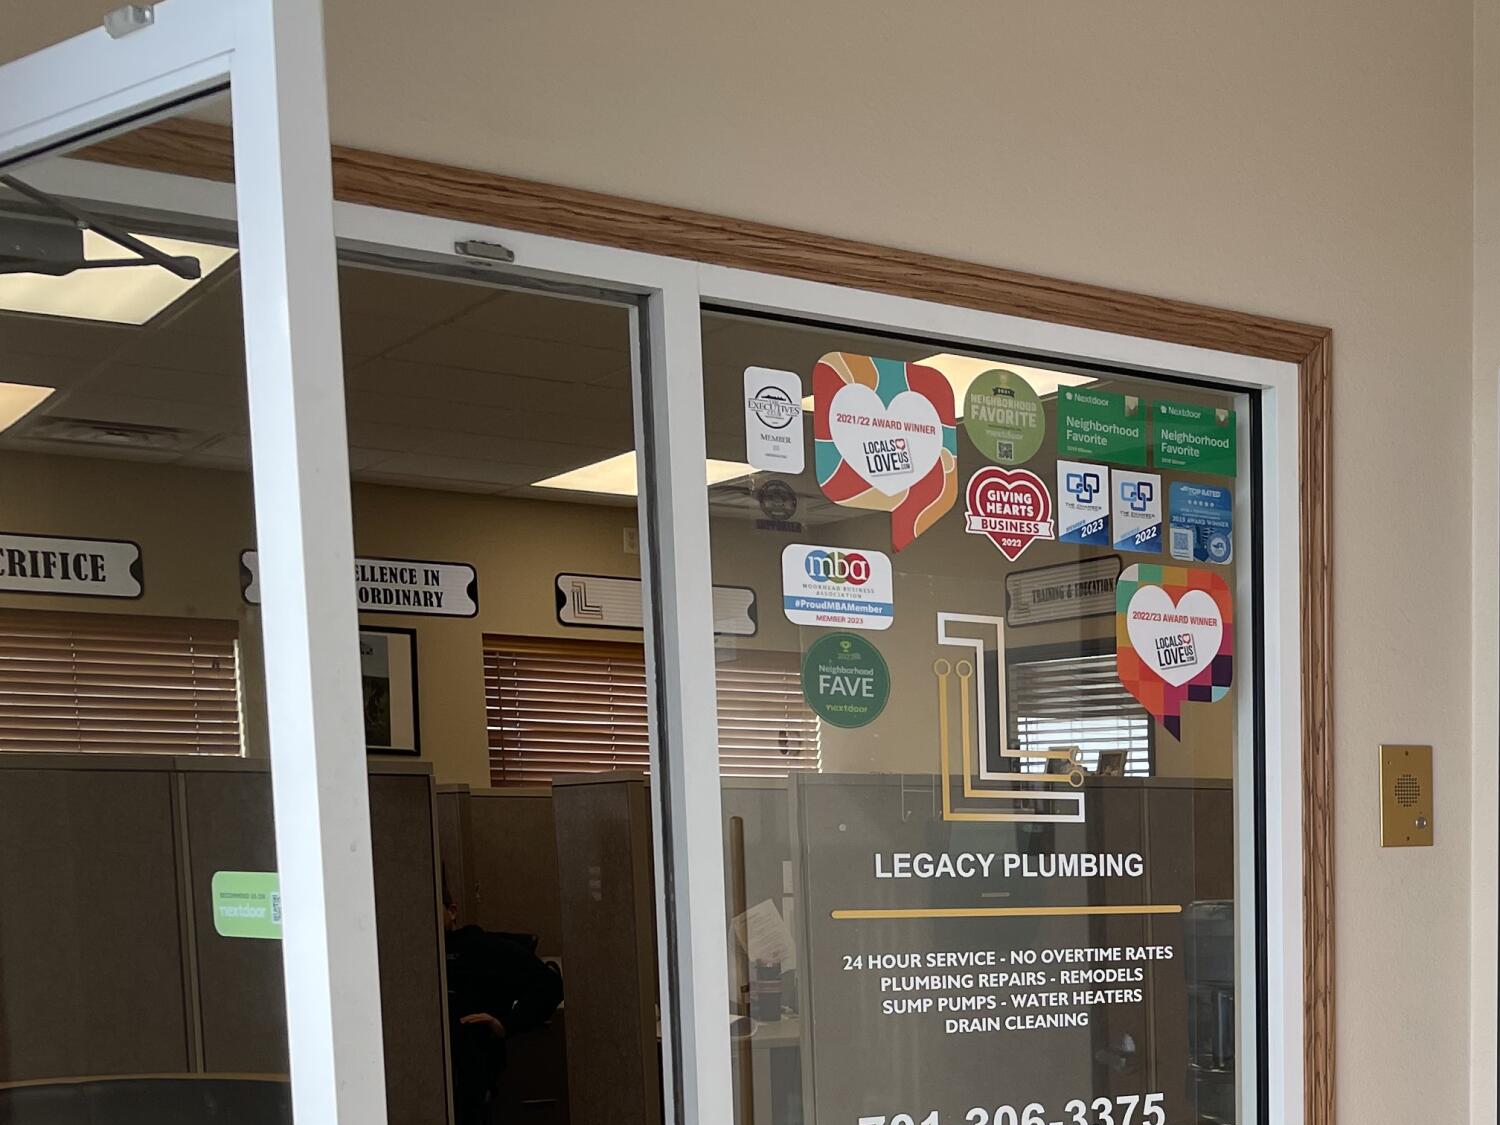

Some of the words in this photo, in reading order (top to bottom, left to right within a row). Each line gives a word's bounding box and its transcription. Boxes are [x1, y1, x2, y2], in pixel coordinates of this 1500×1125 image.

[748, 400, 800, 415] EXECUTIVES
[971, 393, 1037, 411] NEIGHBORHOOD
[1074, 393, 1109, 406] Nextdoor
[971, 404, 1037, 428] FAVORITE
[1168, 406, 1201, 419] Nextdoor
[836, 413, 870, 426] 2021/22
[872, 418, 902, 431] AWARD
[904, 422, 936, 435] WINNER
[1066, 415, 1139, 438] Neighborhood
[760, 433, 791, 444] MEMBER
[1066, 429, 1108, 446] Favorite
[1161, 428, 1230, 449] Neighborhood
[863, 439, 896, 455] LOCALS
[1161, 442, 1200, 458] Favorite
[866, 452, 900, 474] LOVE
[897, 451, 909, 463] US
[987, 490, 1032, 505] GIVING
[986, 502, 1034, 517] HEARTS
[981, 518, 1040, 533] BUSINESS
[1081, 518, 1104, 538] 2023
[1002, 538, 1022, 547] 2022
[1135, 526, 1157, 545] 2022
[808, 551, 867, 580] mba
[423, 569, 440, 586] IN
[358, 586, 443, 608] ORDINARY
[802, 583, 841, 592] MOORHEAD
[843, 586, 875, 594] BUSINESS
[1031, 585, 1065, 604] TRAINING
[1066, 583, 1073, 599] &
[1074, 577, 1114, 598] EDUCATION
[795, 599, 883, 614] #ProudMBAMember
[816, 614, 846, 622] MEMBER
[1132, 610, 1161, 622] 2022/23
[1162, 613, 1189, 624] AWARD
[1190, 616, 1217, 627] WINNER
[1155, 634, 1184, 650] LOCALS
[1157, 647, 1186, 667] LOVE
[1184, 645, 1194, 656] US
[818, 664, 874, 676] Neighborhood
[819, 674, 875, 698] FAVE
[825, 704, 868, 713] nextdoor
[874, 852, 995, 878] LEGACY
[1003, 853, 1144, 878] PLUMBING
[843, 955, 862, 970] 24
[868, 953, 922, 969] HOUR
[926, 951, 996, 968] SERVICE
[1010, 950, 1037, 965] NO
[1041, 947, 1121, 964] OVERTIME
[1125, 946, 1173, 961] RATES
[880, 974, 974, 992] PLUMBING
[978, 971, 1046, 988] REPAIRS
[1060, 967, 1144, 985] REMODELS
[882, 997, 933, 1015] SUMP
[938, 995, 997, 1012] PUMPS
[1010, 992, 1069, 1009] WATER
[1073, 989, 1143, 1005] HEATERS
[945, 1017, 1000, 1034] DRAIN
[1005, 1012, 1089, 1031] CLEANING
